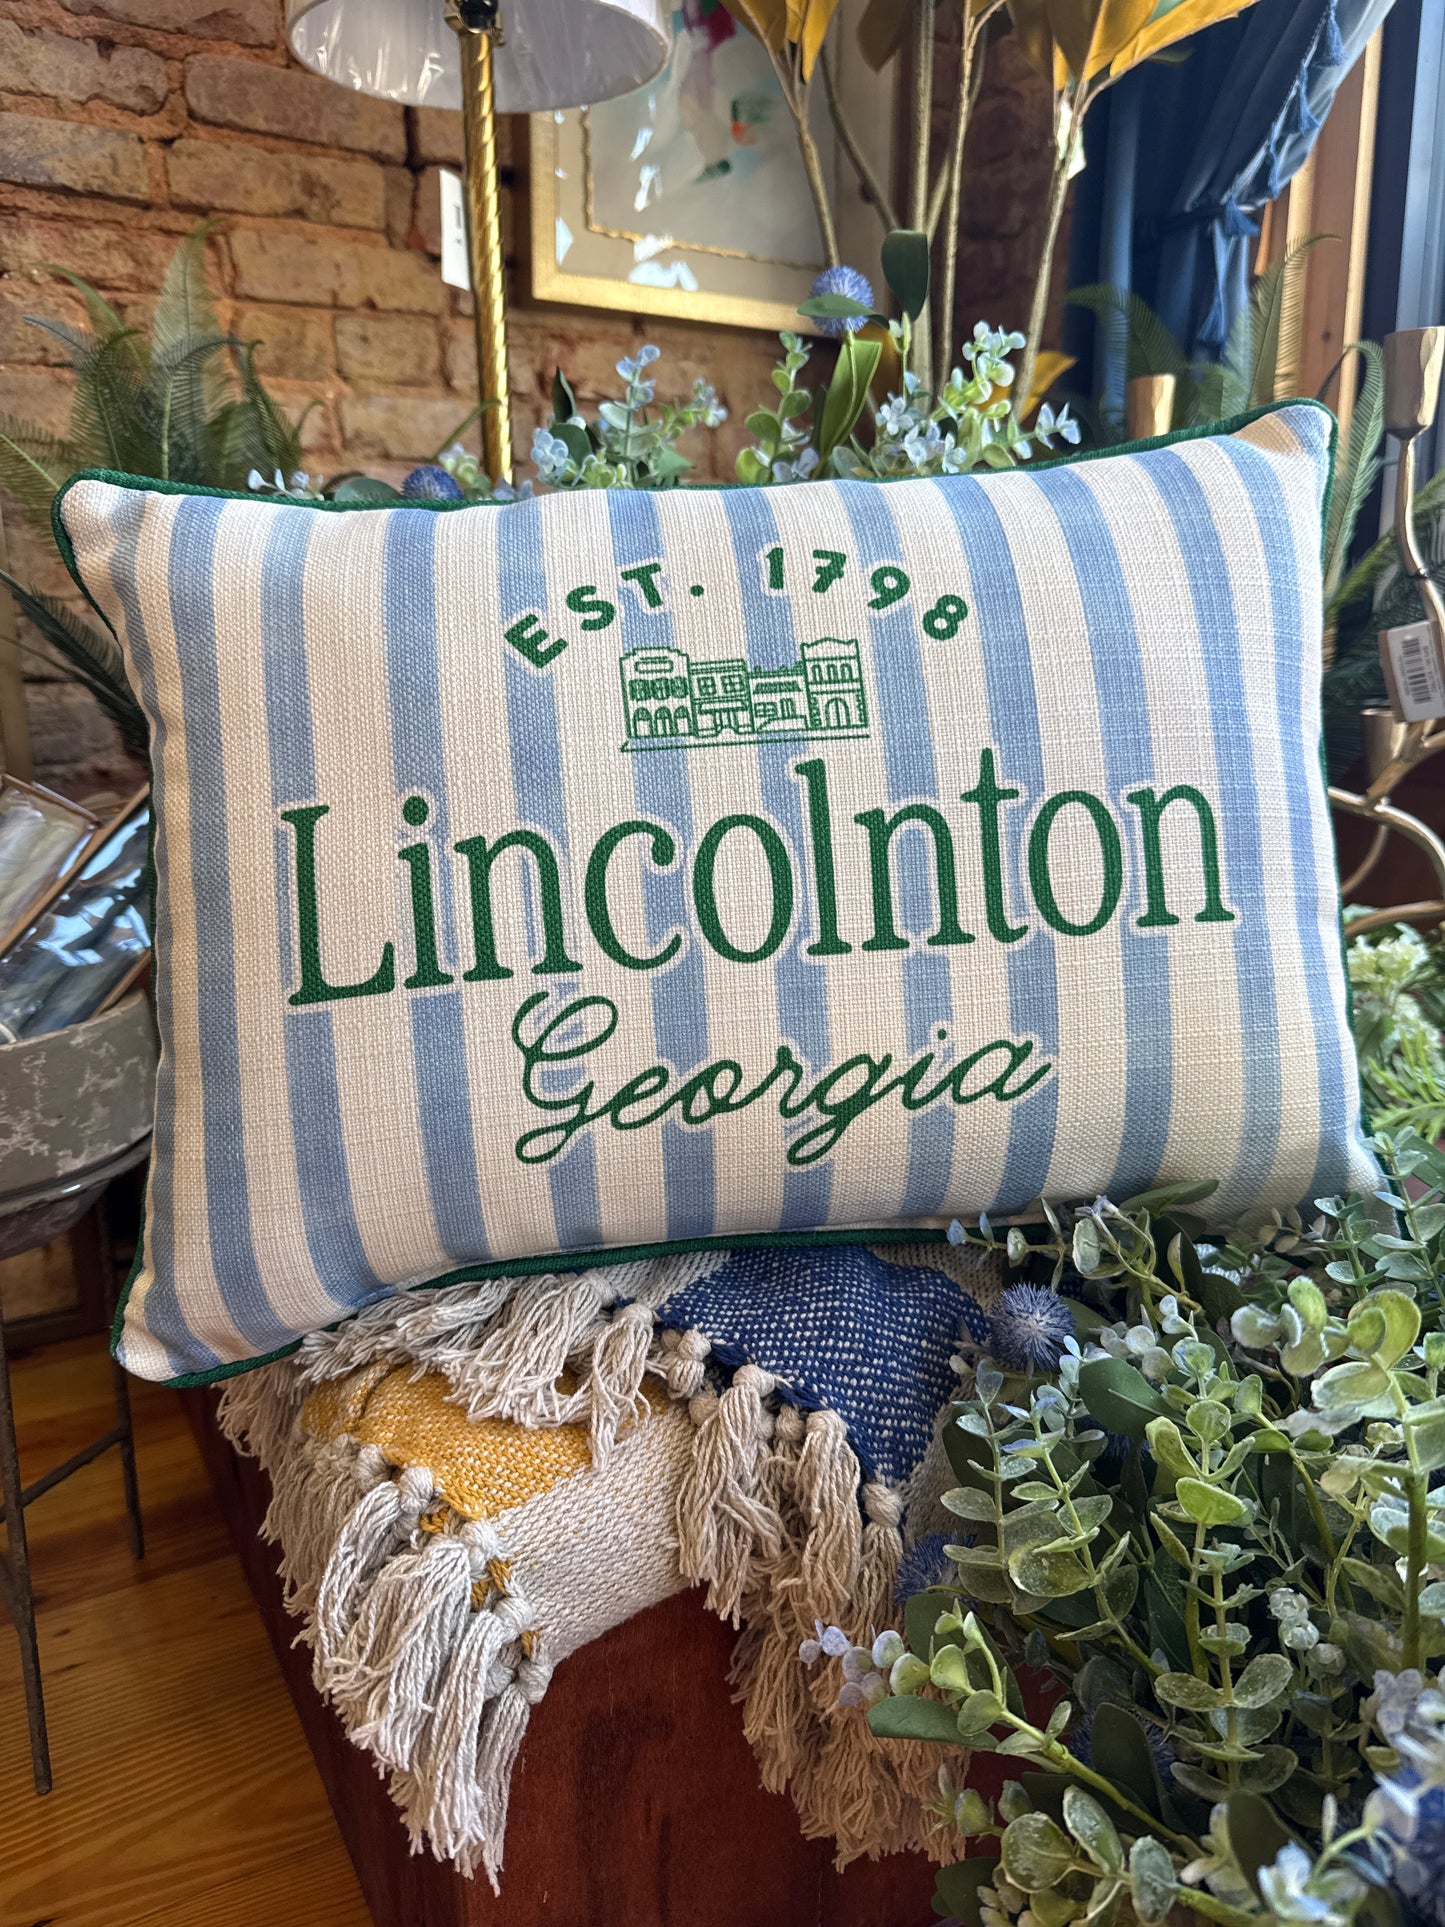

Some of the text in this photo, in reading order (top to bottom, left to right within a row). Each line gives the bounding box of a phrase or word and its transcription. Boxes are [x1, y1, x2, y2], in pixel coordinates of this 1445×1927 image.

[504, 546, 969, 669] EST. 1798
[282, 747, 1235, 1006] Lincolnton
[512, 990, 1052, 1165] Georgia
